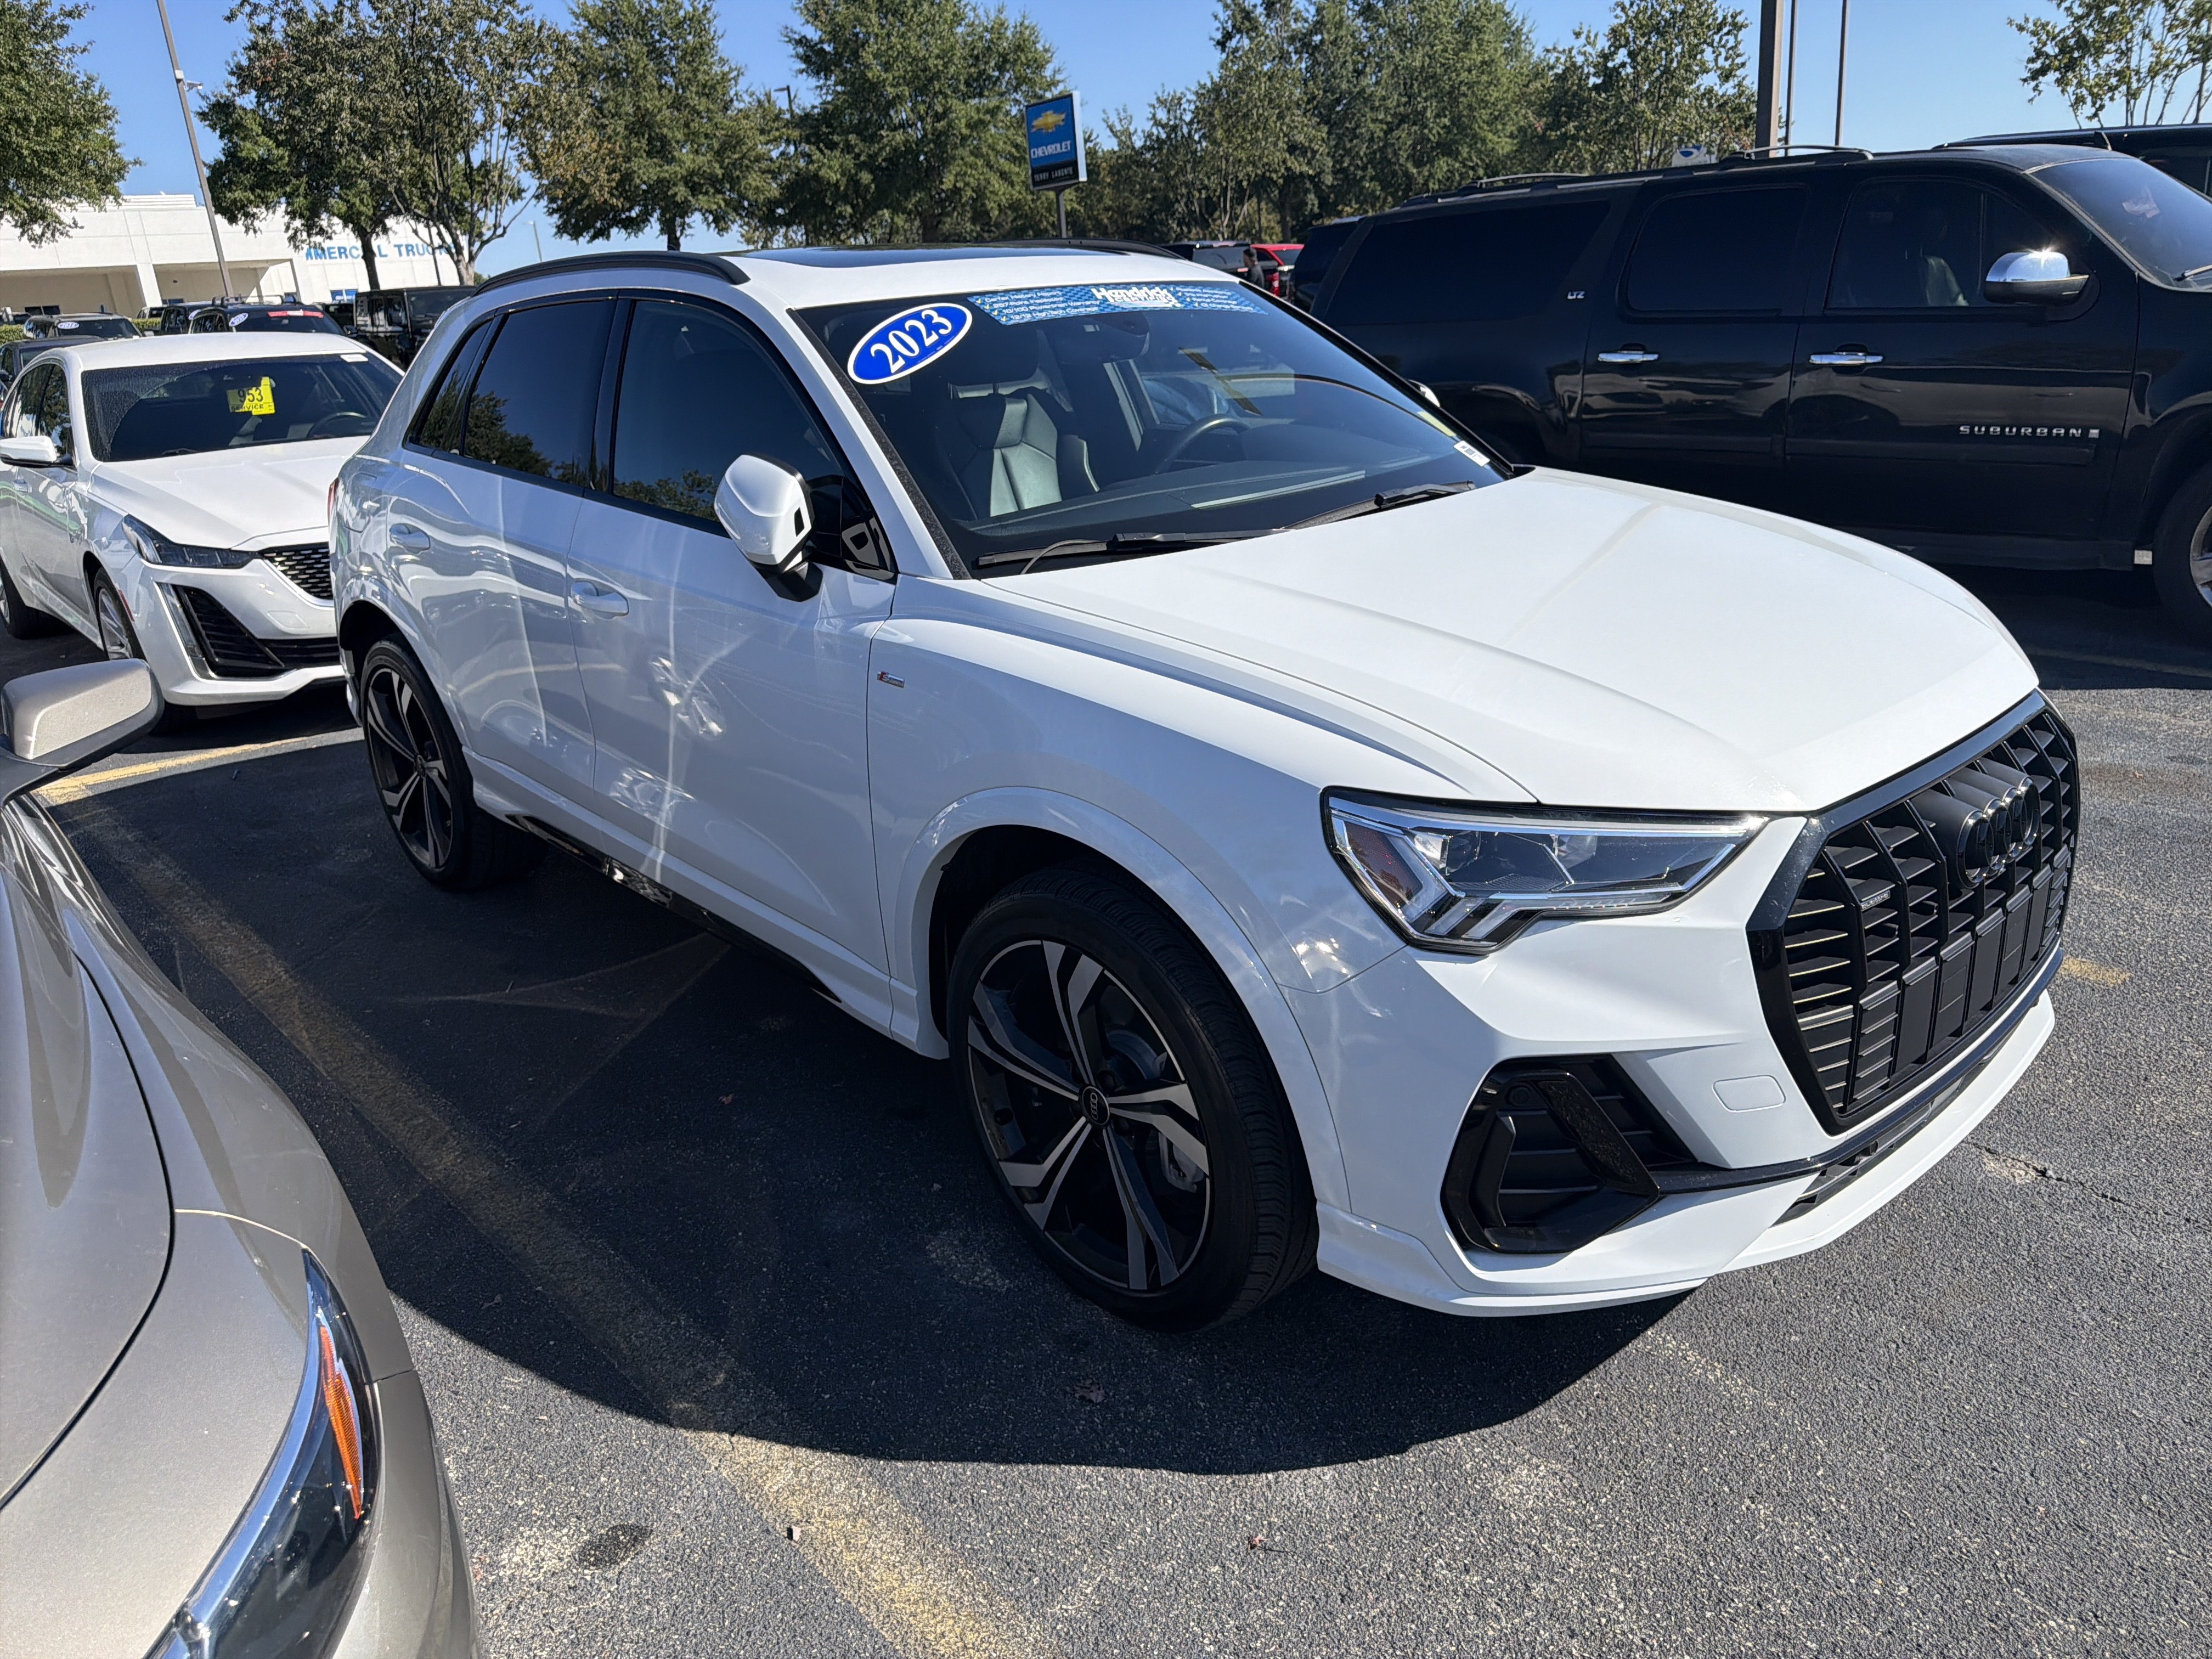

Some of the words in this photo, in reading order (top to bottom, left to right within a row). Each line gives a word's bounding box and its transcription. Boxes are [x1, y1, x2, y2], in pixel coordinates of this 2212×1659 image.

[1030, 140, 1071, 159] CHEVROLET
[1091, 286, 1172, 302] Hendrick
[1567, 291, 1585, 299] LTZ
[871, 309, 952, 374] 2023
[238, 387, 263, 402] 953
[1959, 425, 2081, 437] SUBURBAN
